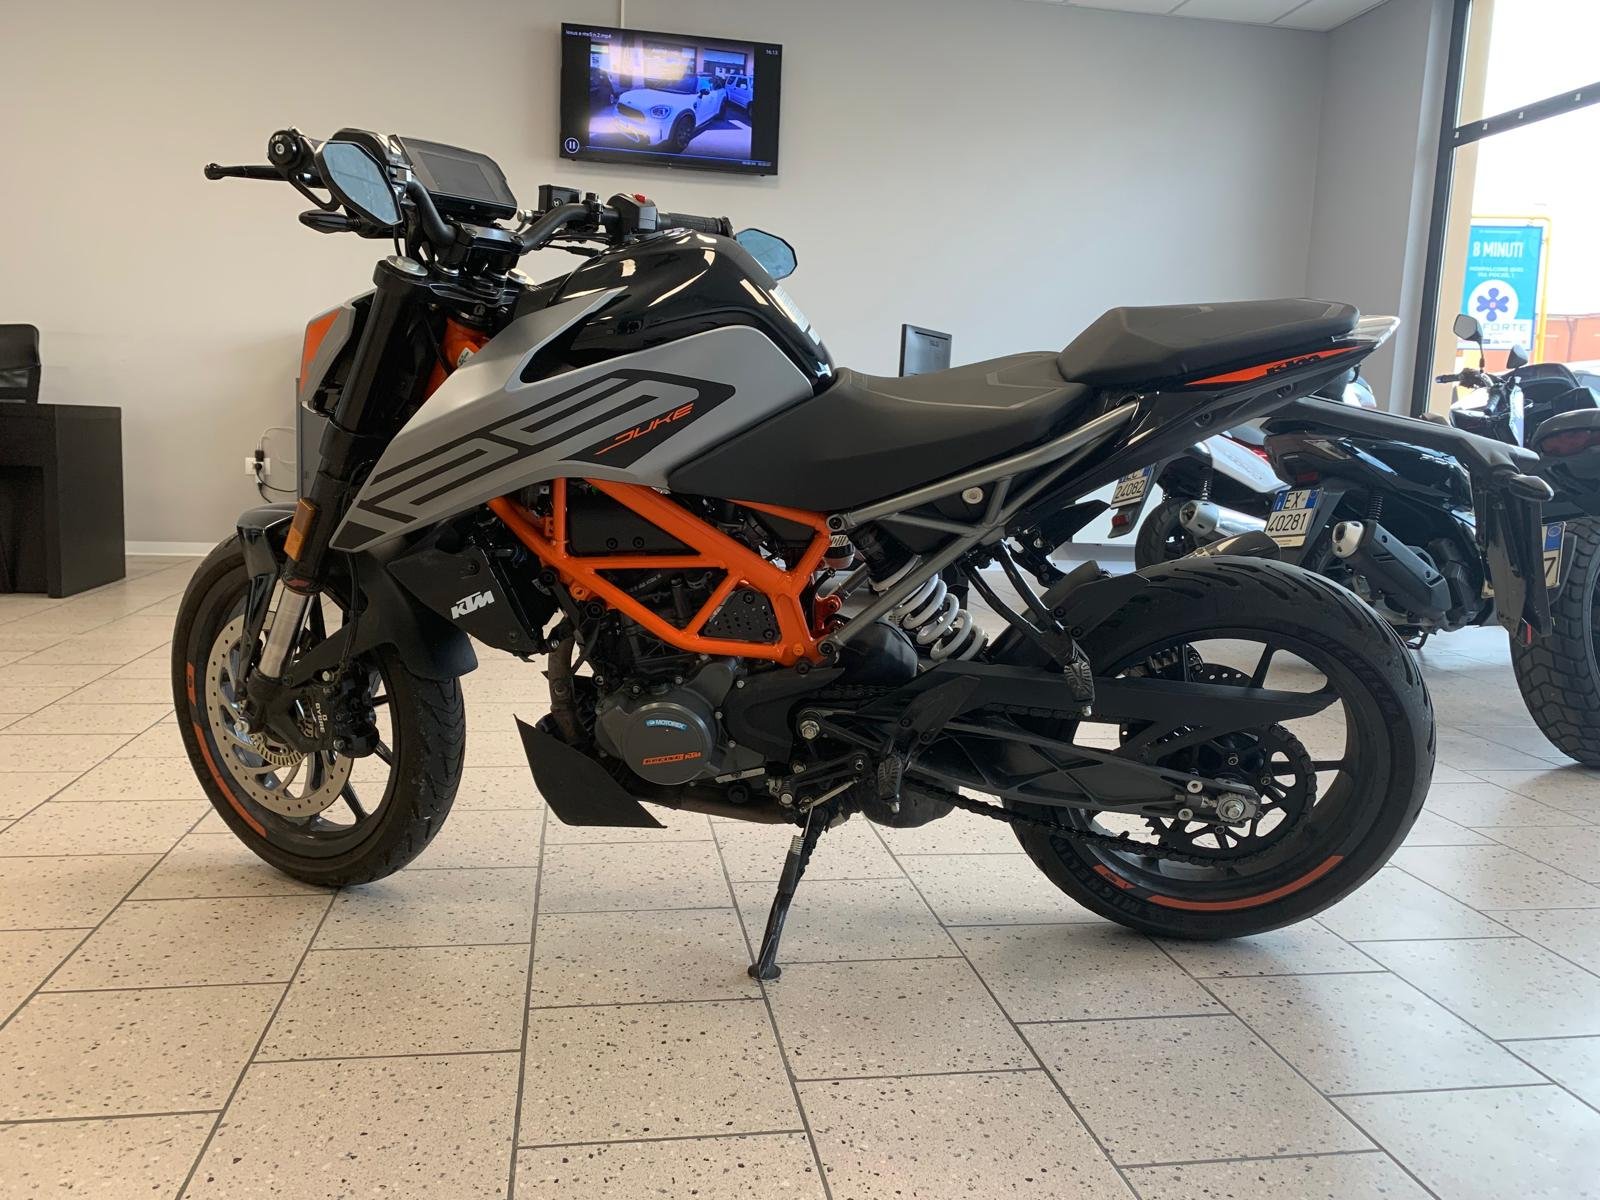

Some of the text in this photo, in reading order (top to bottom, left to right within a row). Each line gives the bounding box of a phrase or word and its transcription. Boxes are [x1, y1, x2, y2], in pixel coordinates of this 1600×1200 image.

[1472, 241, 1524, 258] 8 MINUTI
[594, 401, 695, 456] DUKE
[1115, 479, 1145, 499] 24082
[1283, 491, 1303, 510] EX
[1267, 512, 1307, 532] 40281
[450, 590, 495, 620] KTM
